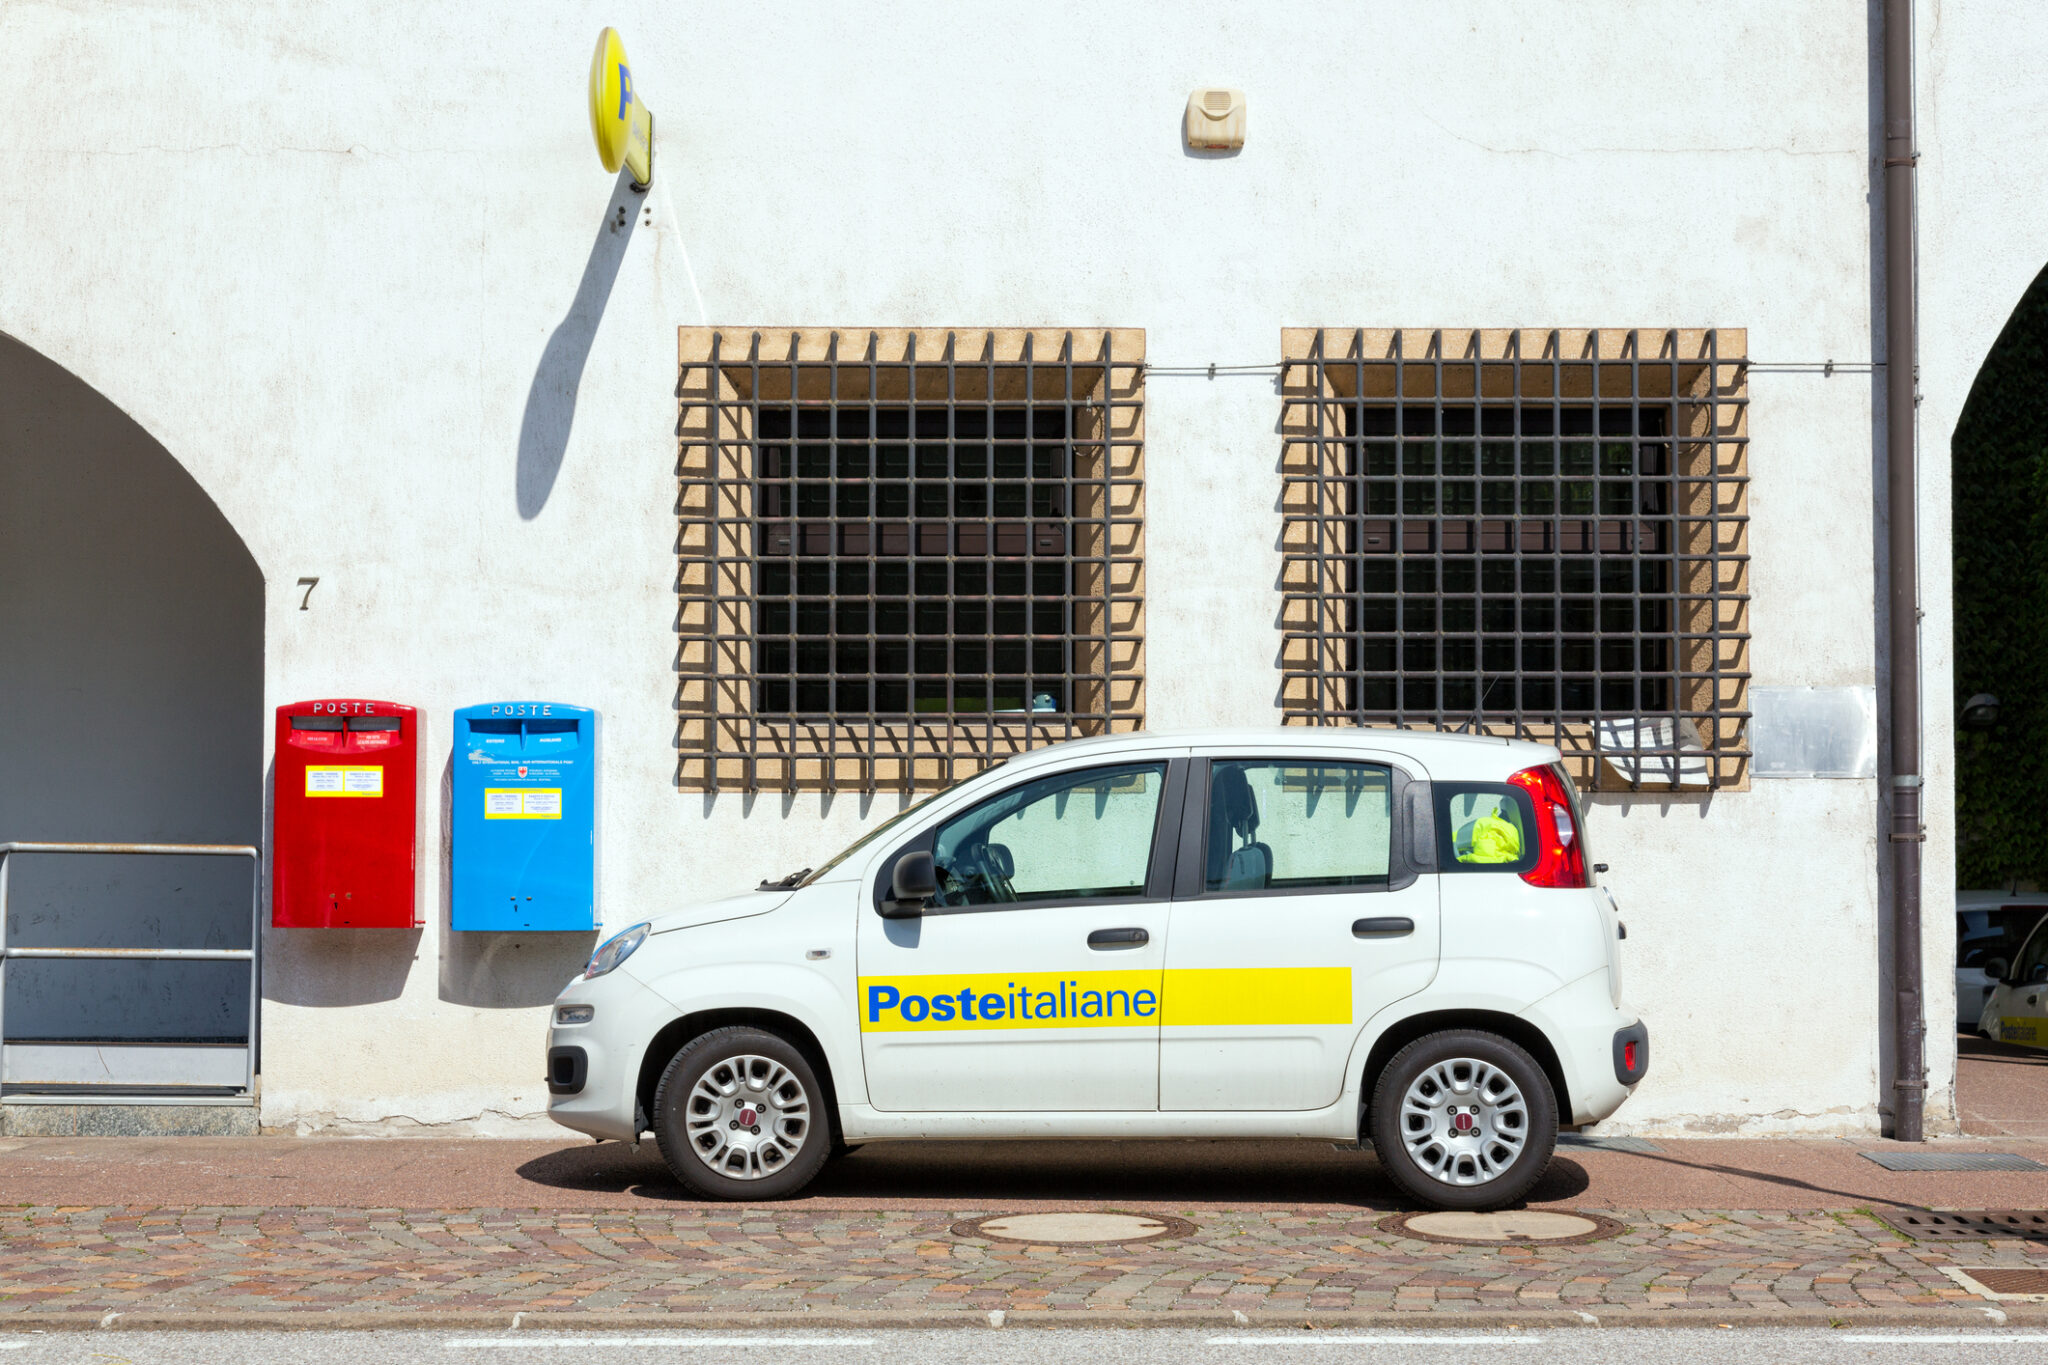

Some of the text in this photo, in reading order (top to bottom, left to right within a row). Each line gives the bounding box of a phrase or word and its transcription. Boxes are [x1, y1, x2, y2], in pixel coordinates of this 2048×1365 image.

[297, 576, 320, 611] 7
[313, 702, 375, 714] POSTE
[491, 704, 552, 716] POSTE
[868, 980, 1157, 1023] Posteitaliane
